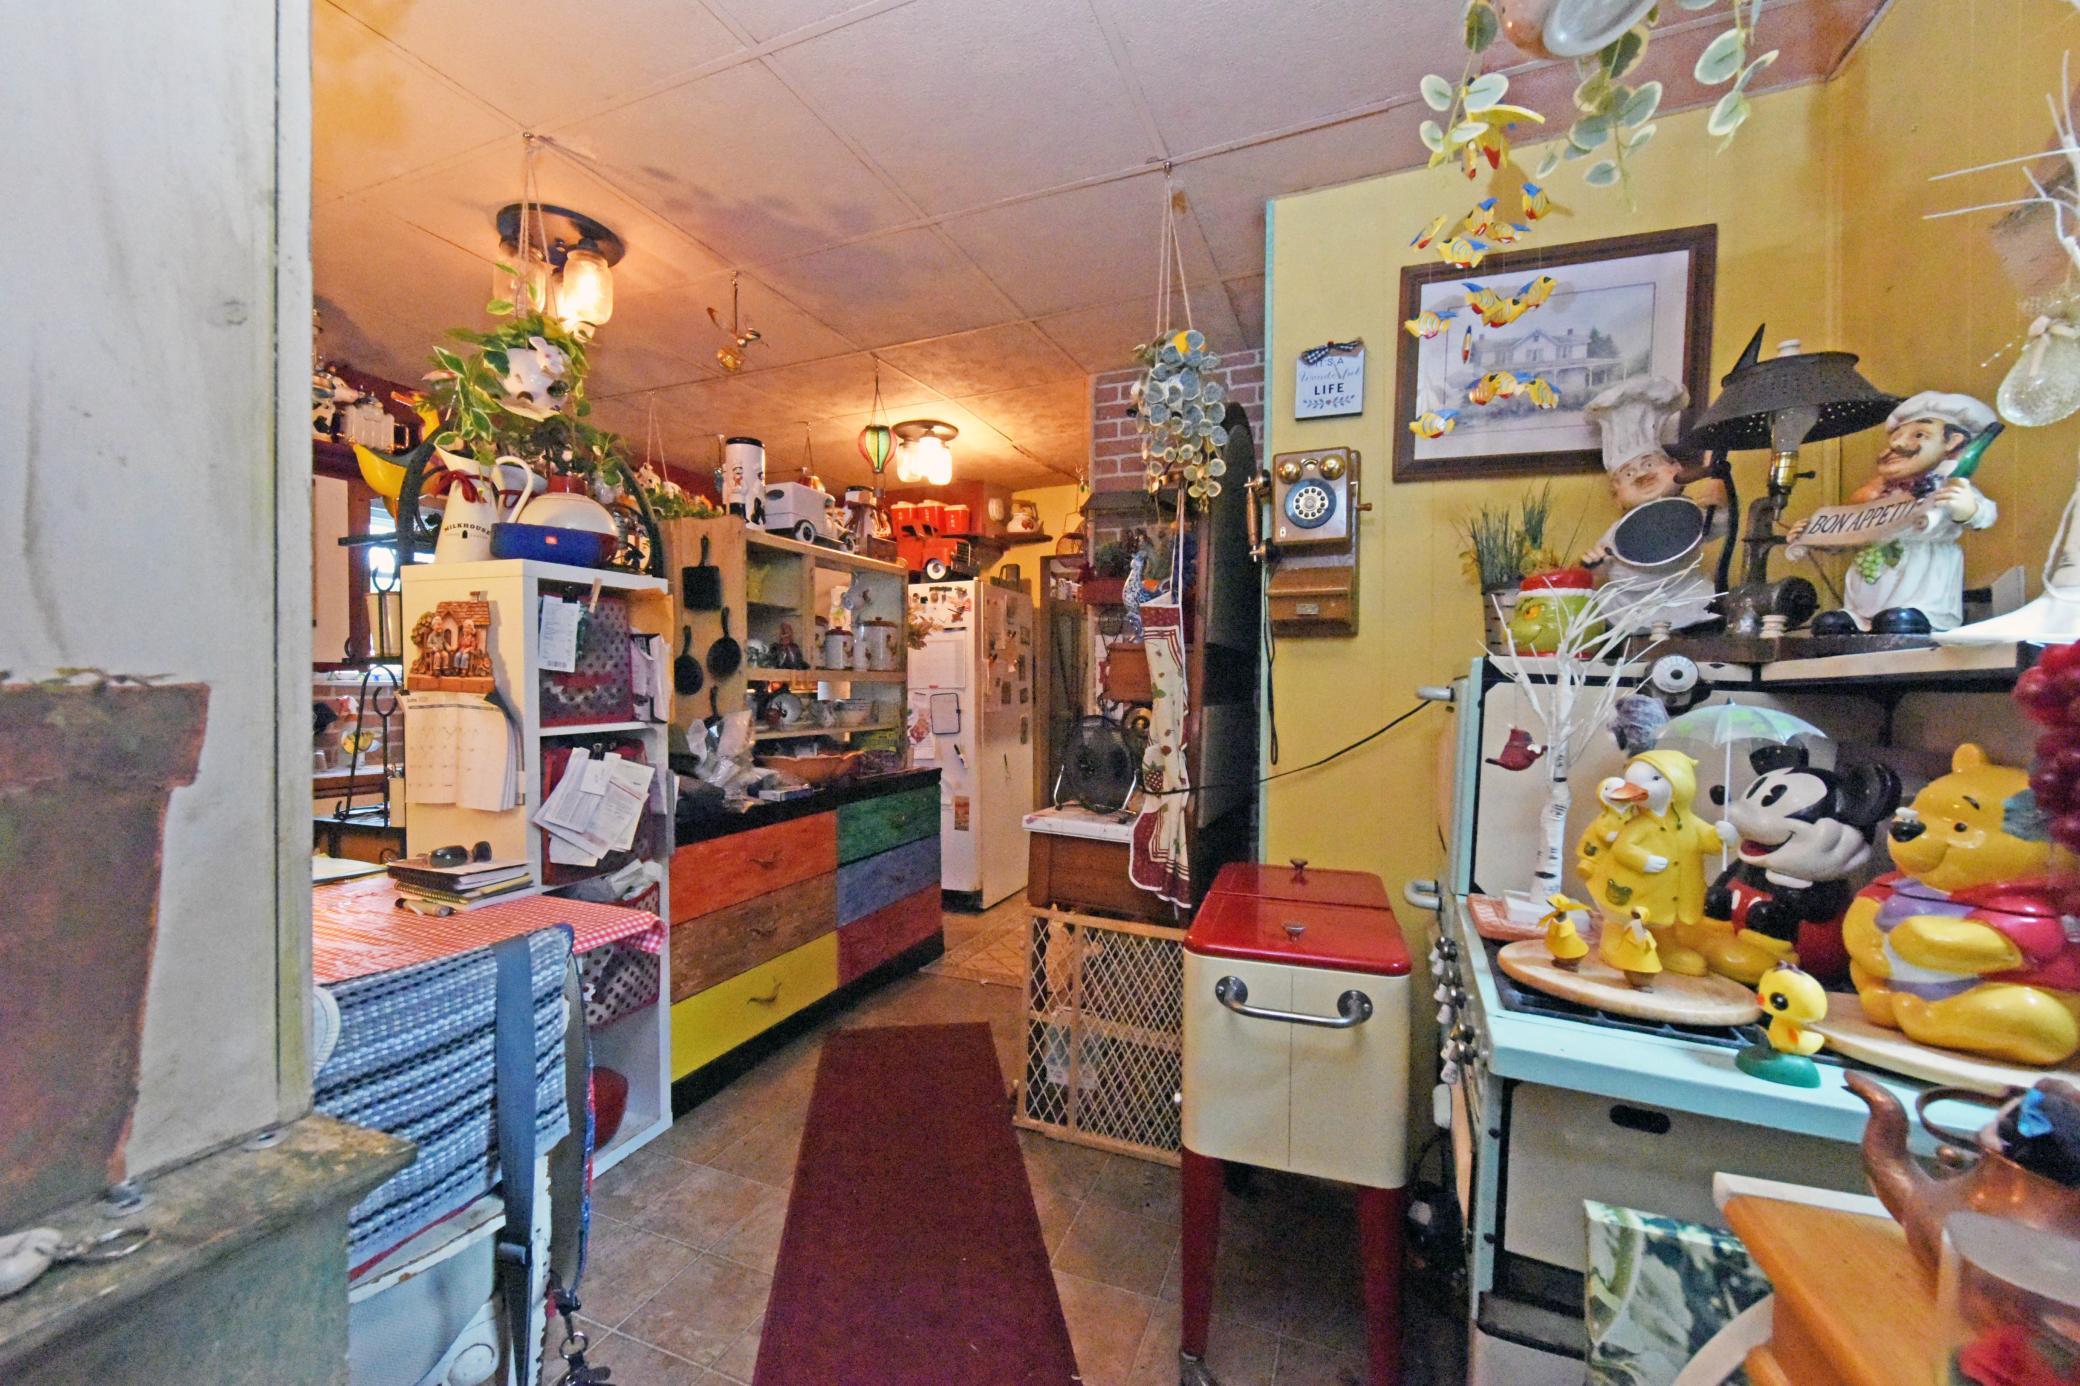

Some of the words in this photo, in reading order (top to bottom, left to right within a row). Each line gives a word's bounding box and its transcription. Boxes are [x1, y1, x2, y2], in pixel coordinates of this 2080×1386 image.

[1314, 383, 1344, 395] LIFE
[1808, 515, 1850, 534] BON
[1846, 499, 1920, 531] APPETIT
[444, 523, 490, 535] MILKHOUSE
